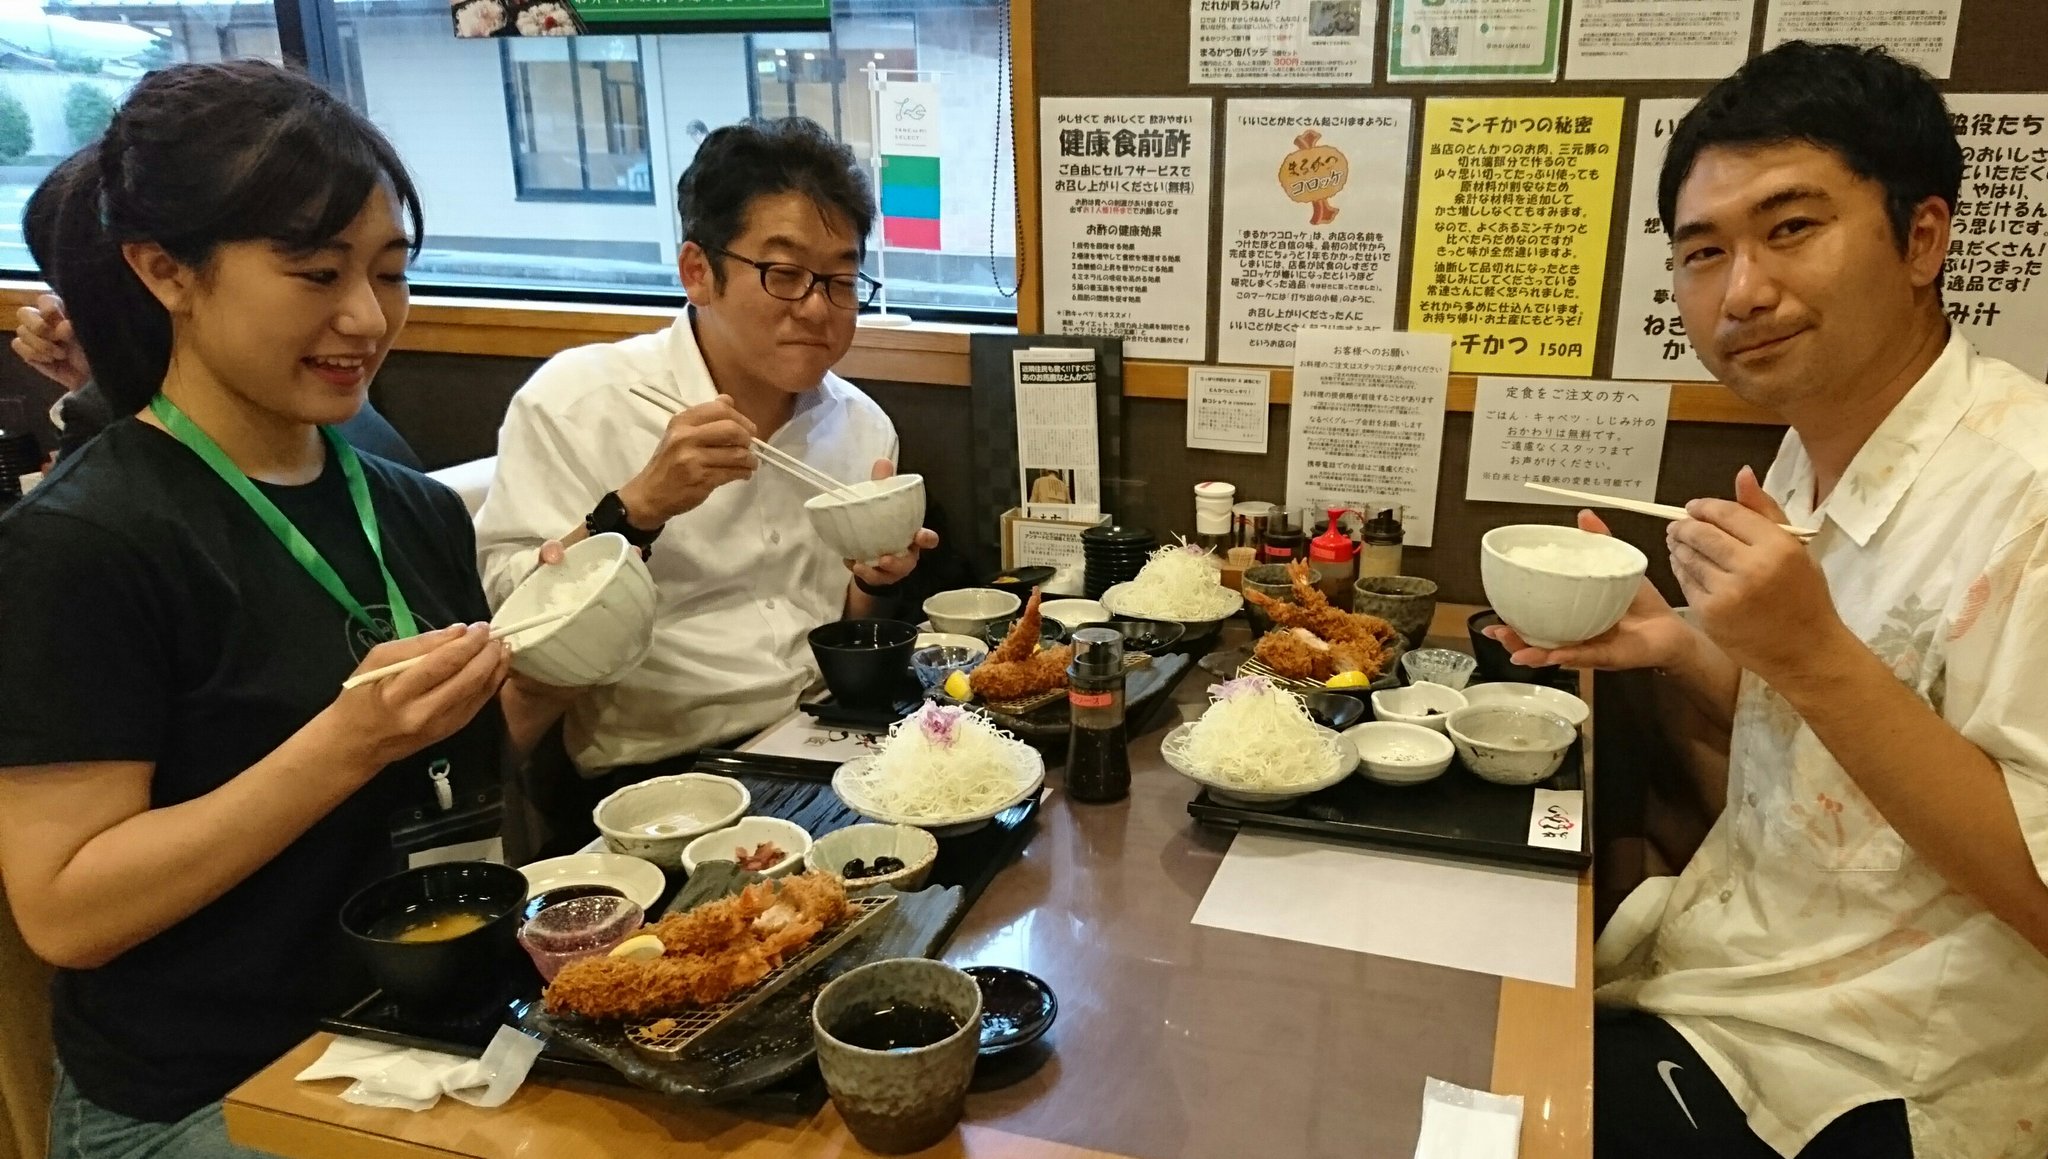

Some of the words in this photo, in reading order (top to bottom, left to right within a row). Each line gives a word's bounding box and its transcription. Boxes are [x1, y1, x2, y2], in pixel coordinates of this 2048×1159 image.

[1274, 57, 1299, 66] 300円
[1058, 114, 1099, 124] 少し甘くて
[1103, 115, 1145, 124] おいしくて
[1150, 115, 1192, 124] 飲みやすい
[1450, 116, 1593, 134] ミンチかつの秘密
[1059, 128, 1191, 157] 健康食前酢
[1430, 143, 1609, 155] 当店のとんかつのお肉、三元豚の
[1458, 156, 1577, 167] 切れ端部分で作るので
[1059, 164, 1191, 177] ご自由にセルフサービスで
[1434, 168, 1599, 180] 少々思い切ってたっぷり使っても
[1291, 169, 1342, 195] コロッケ
[1460, 181, 1569, 193] 原材料が割安なため
[1454, 193, 1574, 205] 余計な材料を追加して
[1435, 206, 1588, 218] かさ増ししなくてもすみます。
[1086, 224, 1162, 237] お酢の健康効果
[1435, 222, 1588, 234] なので、よくあるミンチかつと
[1239, 230, 1383, 242] 「まるかつコロッケ」は、お店の名前を
[1446, 234, 1574, 246] 比べたらだめなのですが
[1235, 240, 1386, 251] つけたほど自信の味。最初の試作から
[1229, 249, 1391, 262] 完成までにちょうど1年もかかったせいで
[1436, 246, 1578, 259] きっと味が全然違いますよ。
[1240, 260, 1378, 271] しまいには、店長が試食のしすぎで
[1434, 262, 1580, 274] 油断して品切れになったとき
[1242, 269, 1374, 281] コロッケが嫌いになったというほど
[1436, 273, 1577, 286] 楽しみにしてくださっている
[1946, 275, 2031, 292] 逸品です!
[1427, 285, 1580, 300] 常連さんに軽く怒られました。
[1248, 308, 1363, 321] お召し上がりくださった人に
[1419, 301, 1584, 315] それから多めに仕込んでいます。
[1333, 346, 1409, 357] お客様へのお願い
[1539, 343, 1583, 358] 150円
[1299, 361, 1443, 373] お料理のご注文はスタッフにお声がけください
[1506, 386, 1640, 403] 定食をご注文の方へ
[1486, 410, 1656, 427] ごはん・キャベツ・しじみ汁の
[1507, 427, 1622, 442] おかわりは無料です。
[1500, 441, 1634, 456] ご遠慮なくスタッフまで
[1307, 460, 1418, 473] 携帯電話での会話はご遠慮ください
[1510, 456, 1611, 471] お声がけください。
